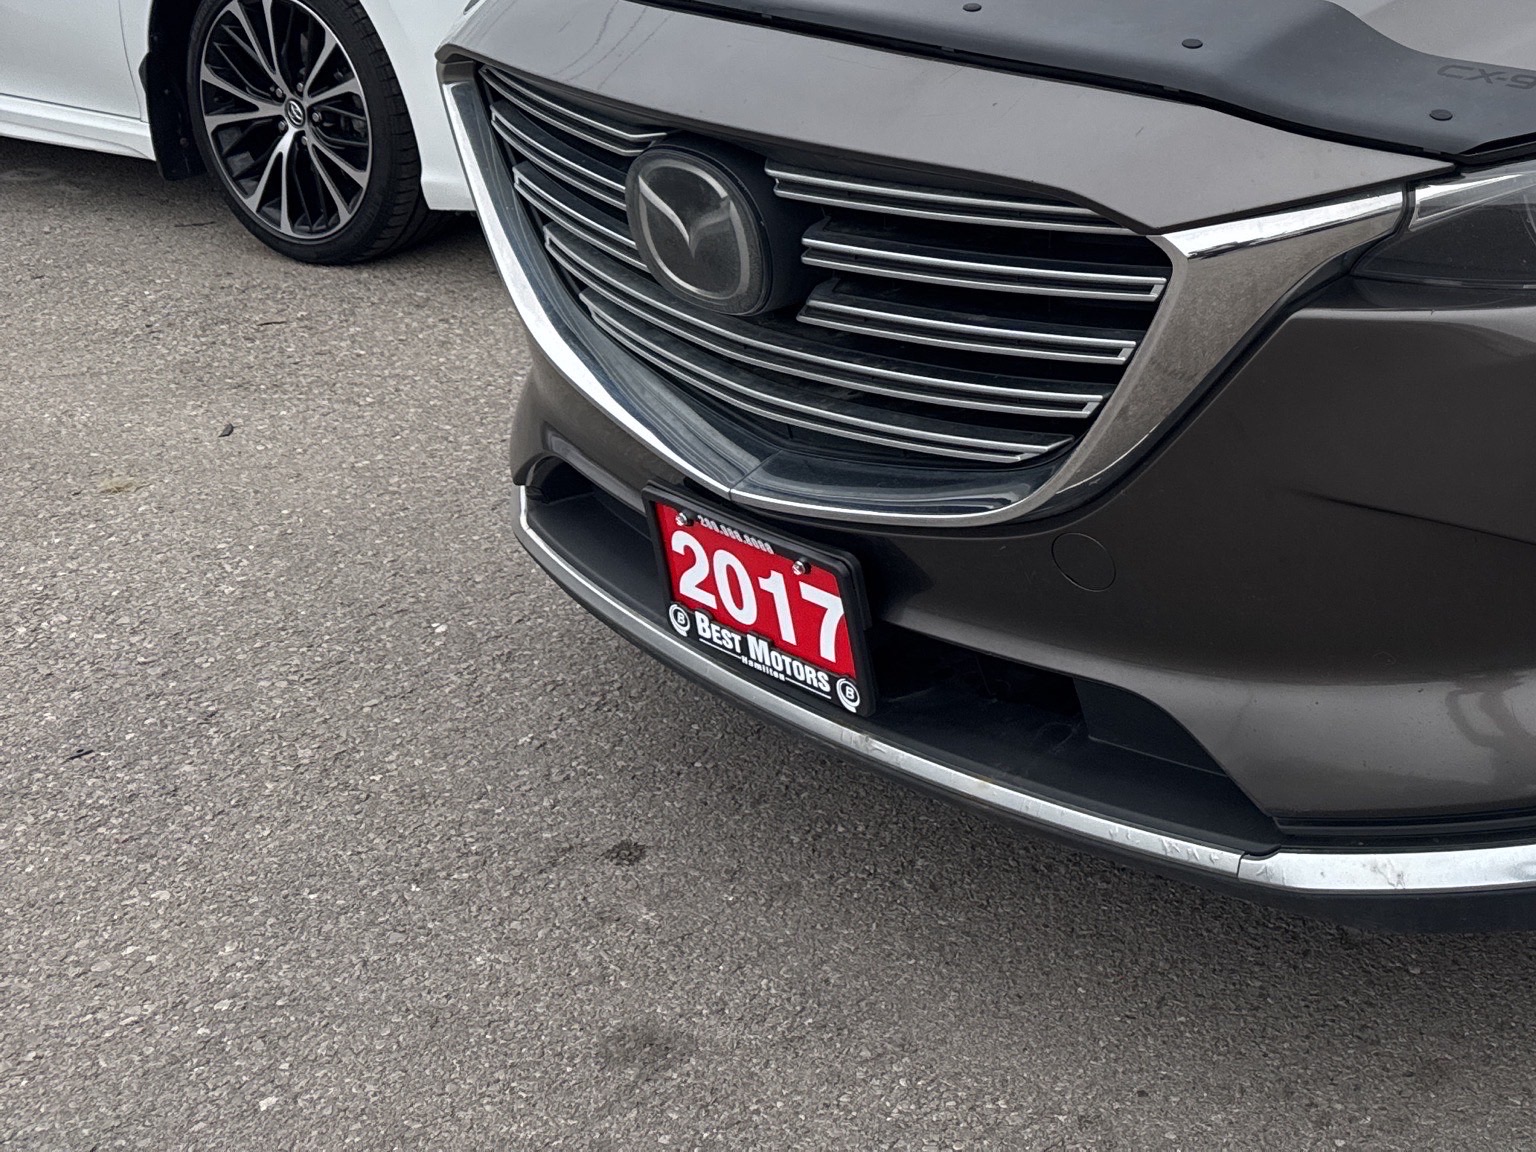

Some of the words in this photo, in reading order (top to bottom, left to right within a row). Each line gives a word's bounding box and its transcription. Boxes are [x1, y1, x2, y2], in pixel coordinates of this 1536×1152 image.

[671, 530, 845, 663] 2017
[694, 611, 743, 653] BEST
[746, 633, 832, 693] MOTORS
[741, 655, 787, 681] Hamilton
